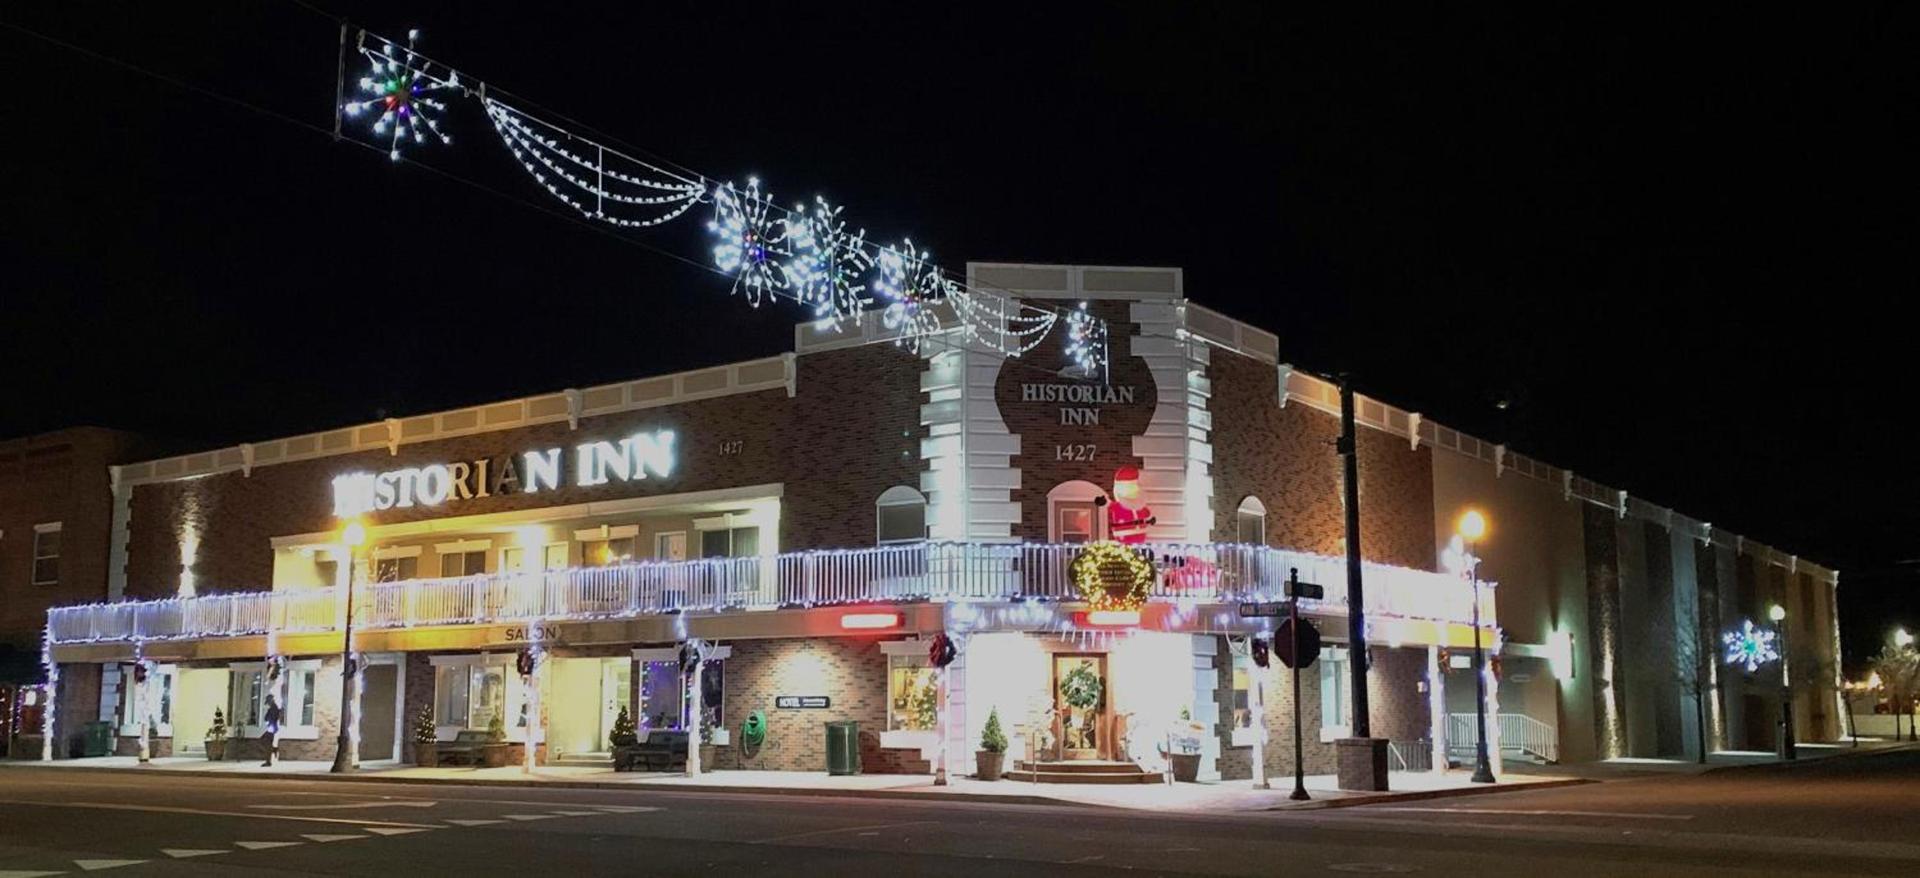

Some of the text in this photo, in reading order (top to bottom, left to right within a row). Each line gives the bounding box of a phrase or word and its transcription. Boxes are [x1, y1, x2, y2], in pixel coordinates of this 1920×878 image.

[1021, 383, 1135, 404] HISTORIAN
[1060, 408, 1100, 425] INN
[719, 440, 744, 456] 1427
[1055, 443, 1096, 461] 1427
[576, 430, 675, 487] INN
[505, 626, 557, 641] SALON
